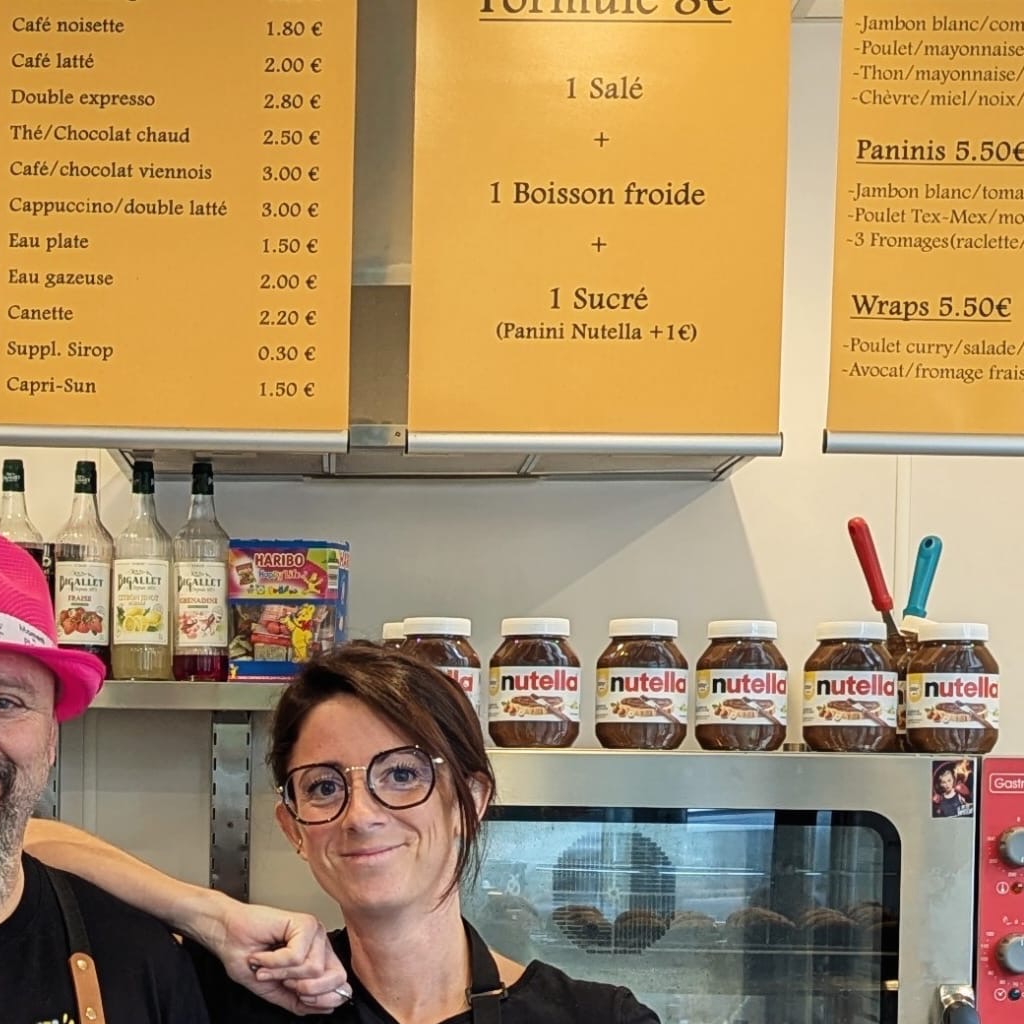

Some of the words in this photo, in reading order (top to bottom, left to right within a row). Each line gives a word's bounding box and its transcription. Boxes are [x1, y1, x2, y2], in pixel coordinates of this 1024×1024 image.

[13, 17, 51, 32] Café
[57, 17, 124, 33] noisette
[267, 21, 305, 36] 1.80
[311, 22, 322, 36] €
[856, 16, 926, 34] -Jambon
[854, 40, 1024, 60] -Poulet/mayonnaise
[12, 53, 51, 68] Café
[56, 53, 94, 68] latté
[265, 58, 304, 72] 2.00
[310, 58, 321, 73] €
[567, 78, 576, 99] 1
[590, 76, 643, 99] Salé
[11, 89, 73, 104] Double
[80, 94, 155, 109] expresso
[264, 94, 303, 109] 2.80
[310, 94, 320, 109] €
[10, 124, 131, 141] Thé/Chocolat
[137, 127, 189, 143] chaud
[263, 130, 302, 145] 2.50
[309, 131, 320, 145] €
[857, 140, 945, 161] Paninis
[956, 141, 1024, 161] 5.50€
[10, 160, 133, 177] Café/chocolat
[139, 163, 212, 179] viennois
[263, 166, 302, 181] 3.00
[308, 167, 319, 181] €
[491, 182, 500, 203] 1
[513, 182, 614, 204] Boisson
[625, 182, 705, 205] froide
[848, 183, 918, 201] -Jambon
[9, 198, 183, 216] Cappuccino/double
[190, 200, 227, 216] latté
[262, 202, 301, 217] 3.00
[308, 203, 318, 217] €
[848, 208, 905, 223] -Poulet
[9, 233, 40, 247] Eau
[46, 233, 88, 252] plate
[263, 239, 300, 253] 1.50
[306, 239, 318, 253] €
[9, 269, 38, 284] Eau
[45, 273, 113, 288] gazeuse
[260, 274, 299, 289] 2.00
[306, 275, 317, 289] €
[551, 288, 560, 309] 1
[574, 287, 648, 310] Sucré
[851, 295, 930, 321] Wraps
[939, 297, 1011, 317] 5.50€
[8, 305, 73, 320] Canette
[259, 311, 299, 325] 2.20
[305, 311, 316, 325] €
[496, 322, 564, 340] (Panini
[572, 323, 642, 340] Nutella
[7, 341, 61, 360] Suppl.
[68, 342, 113, 361] Sirop
[258, 346, 298, 360] 0.30
[304, 346, 315, 361] €
[843, 338, 900, 353] -Poulet
[842, 362, 983, 384] -Avocat/fromage
[989, 365, 1024, 380] frais
[7, 377, 96, 396] Capri-Sun
[261, 382, 297, 397] 1.50
[304, 383, 314, 397] €
[254, 552, 304, 567] HARIBO
[501, 669, 578, 691] nutella
[611, 670, 686, 693] nutella
[712, 672, 786, 695] nutella
[817, 674, 895, 697] nutella
[925, 676, 998, 698] nutella
